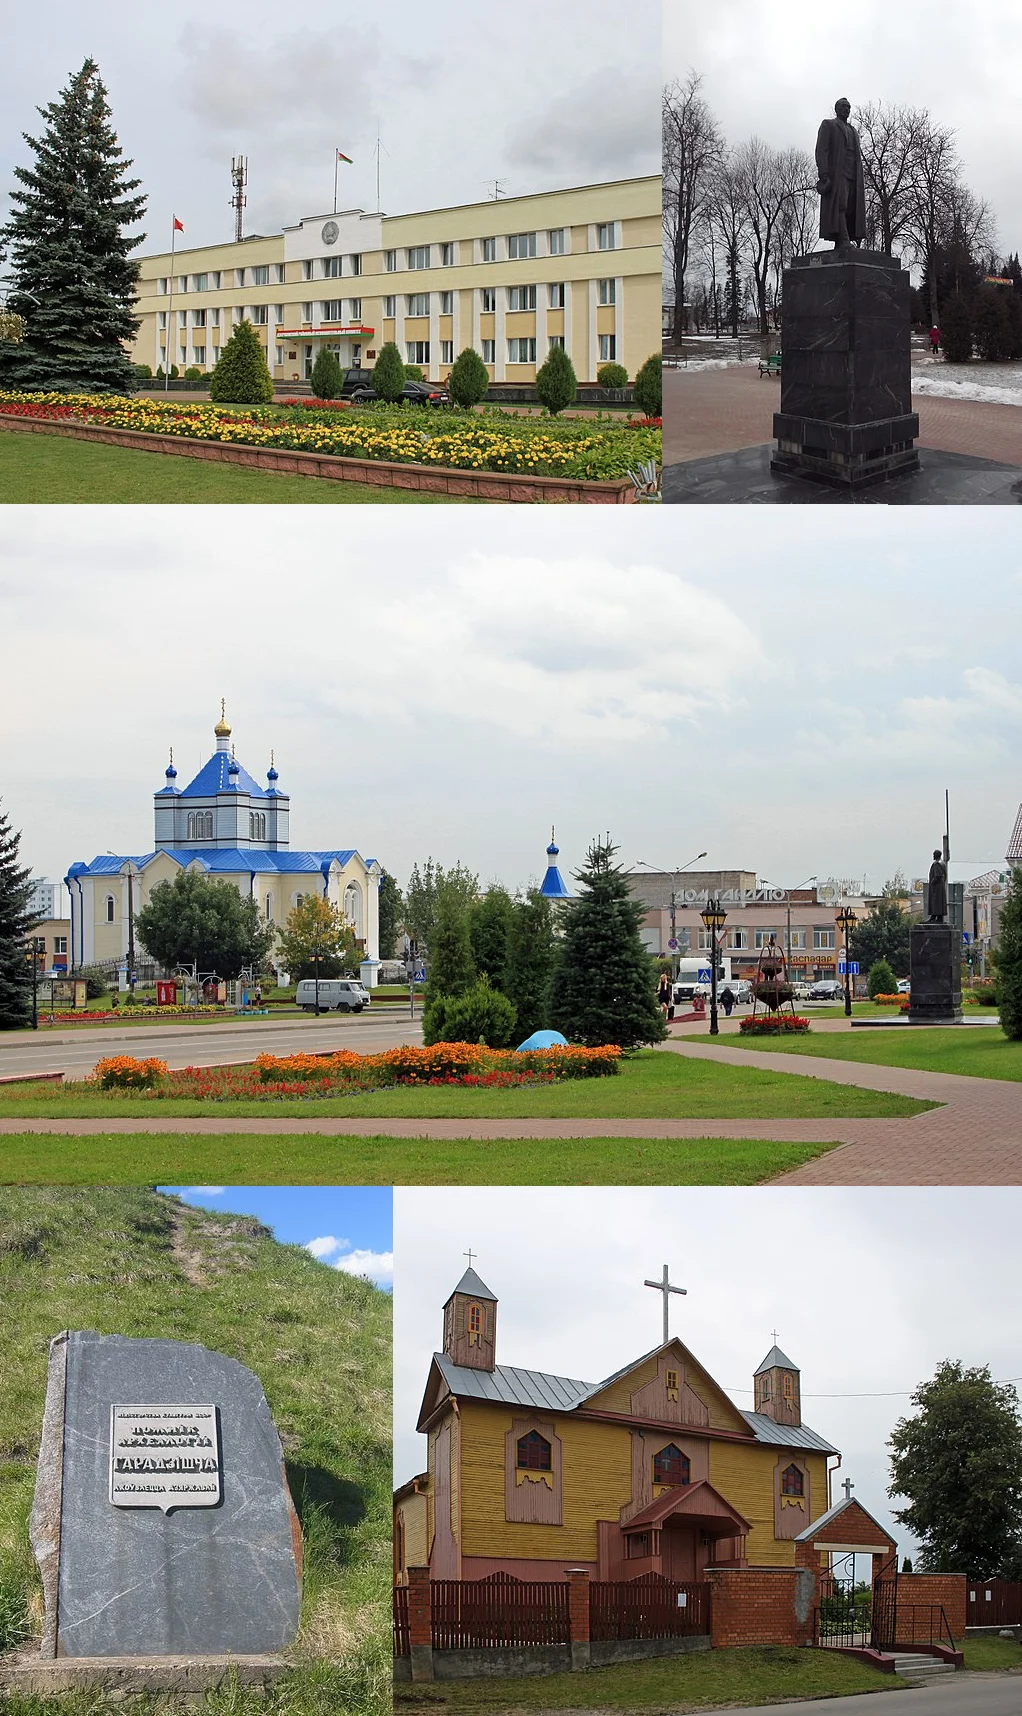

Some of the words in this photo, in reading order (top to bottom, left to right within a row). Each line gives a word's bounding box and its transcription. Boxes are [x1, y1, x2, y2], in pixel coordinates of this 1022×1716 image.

[674, 888, 709, 902] ДОМ
[714, 888, 786, 902] ГАНДЛЮ
[112, 1456, 217, 1473] ГАРАДЗІШЧА
